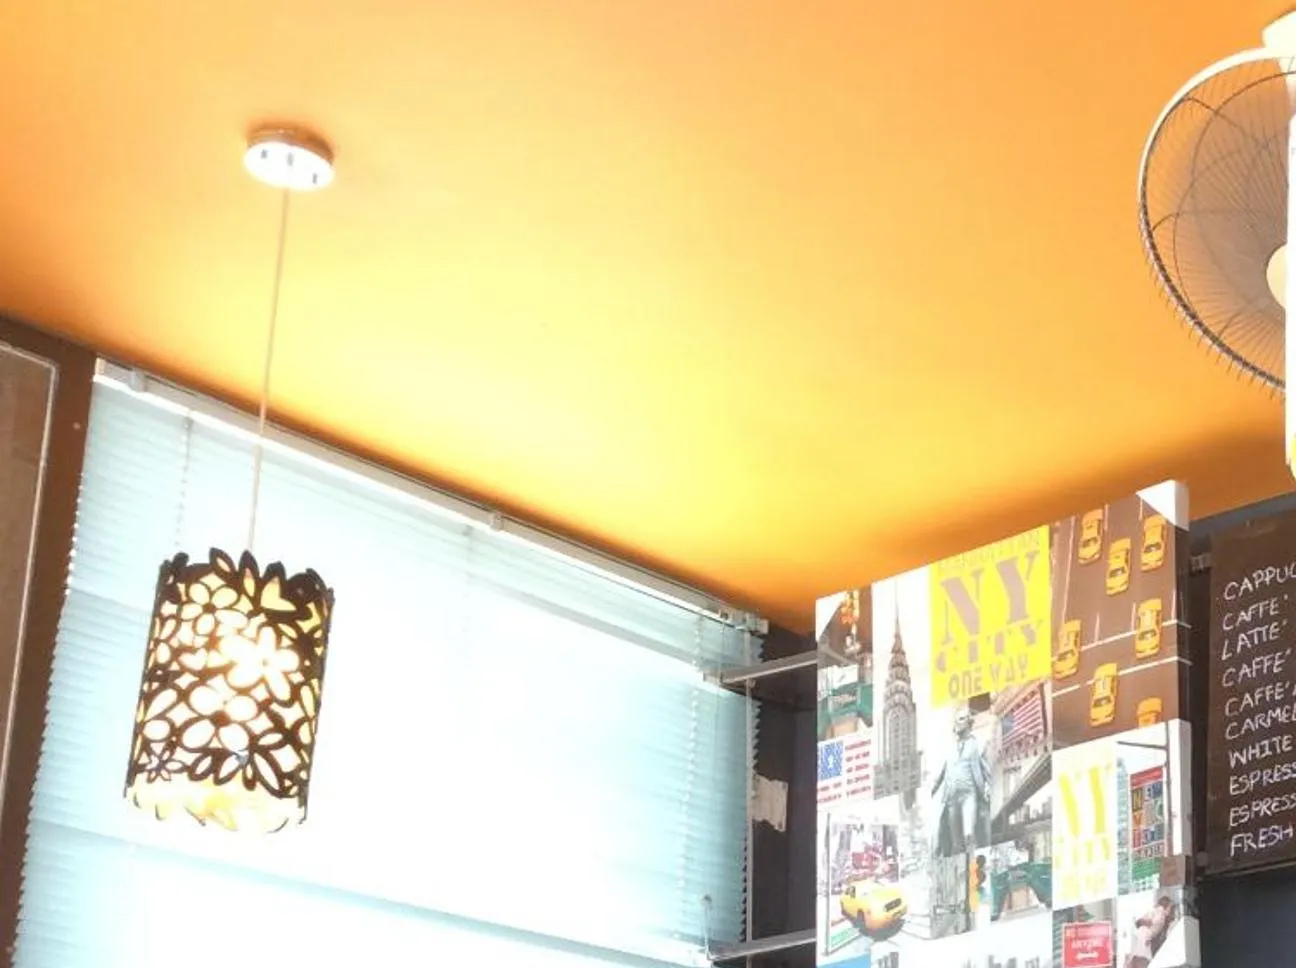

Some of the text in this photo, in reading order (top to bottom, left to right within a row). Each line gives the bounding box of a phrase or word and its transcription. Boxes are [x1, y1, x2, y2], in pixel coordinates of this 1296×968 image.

[939, 549, 1041, 646] NY
[935, 619, 1045, 674] CITY
[948, 667, 983, 698] ONE
[1229, 735, 1294, 768] WHITE
[1230, 822, 1294, 857] FRESH
